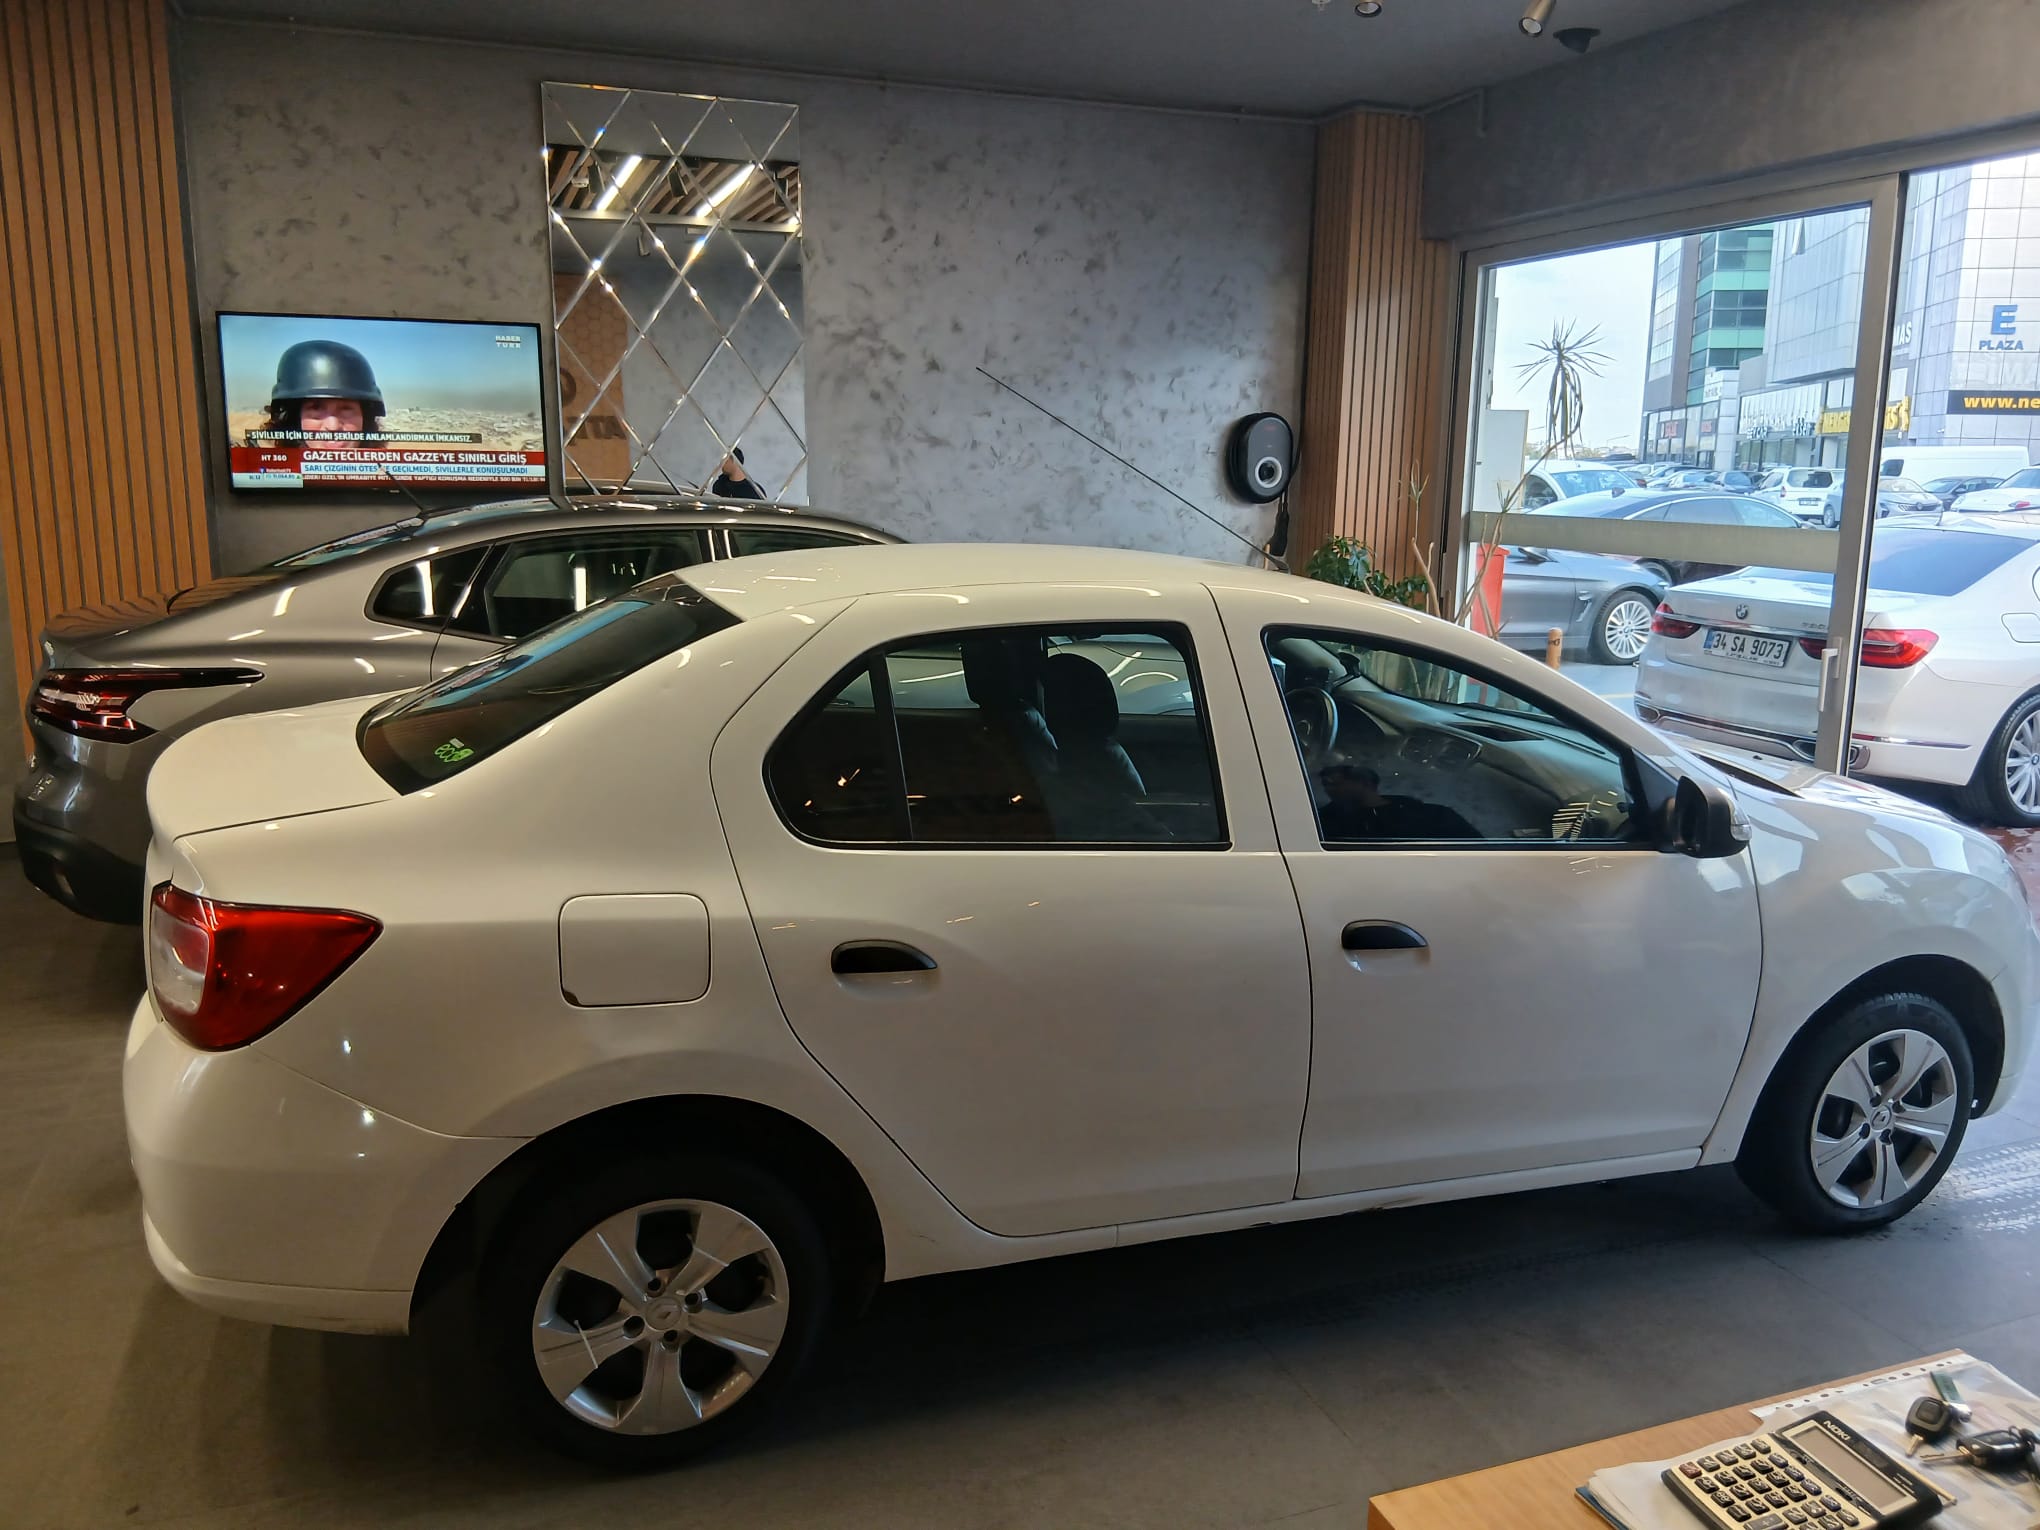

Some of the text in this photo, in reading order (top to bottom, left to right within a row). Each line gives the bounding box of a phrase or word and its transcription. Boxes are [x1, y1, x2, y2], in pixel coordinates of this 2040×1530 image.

[1991, 305, 2018, 335] E
[1979, 340, 2024, 350] PLAZA
[252, 430, 284, 440] SİVİLLER
[286, 430, 302, 441] İÇİN
[304, 432, 314, 440] DE
[315, 432, 332, 440] AYNI
[334, 431, 364, 442] ŞEKİLDE
[303, 450, 527, 465] GAZETECİLERDEN GAZZE'YE SINIRLI GİRİŞ
[325, 464, 357, 473] ÇİZGİNİN
[436, 466, 472, 474] SİVİLLERLE
[476, 467, 528, 475] KONUŞULMADI
[1713, 634, 1726, 650] 34
[1731, 636, 1746, 654] SA
[1750, 640, 1784, 660] 9073
[1823, 1420, 1851, 1440] NOKI
